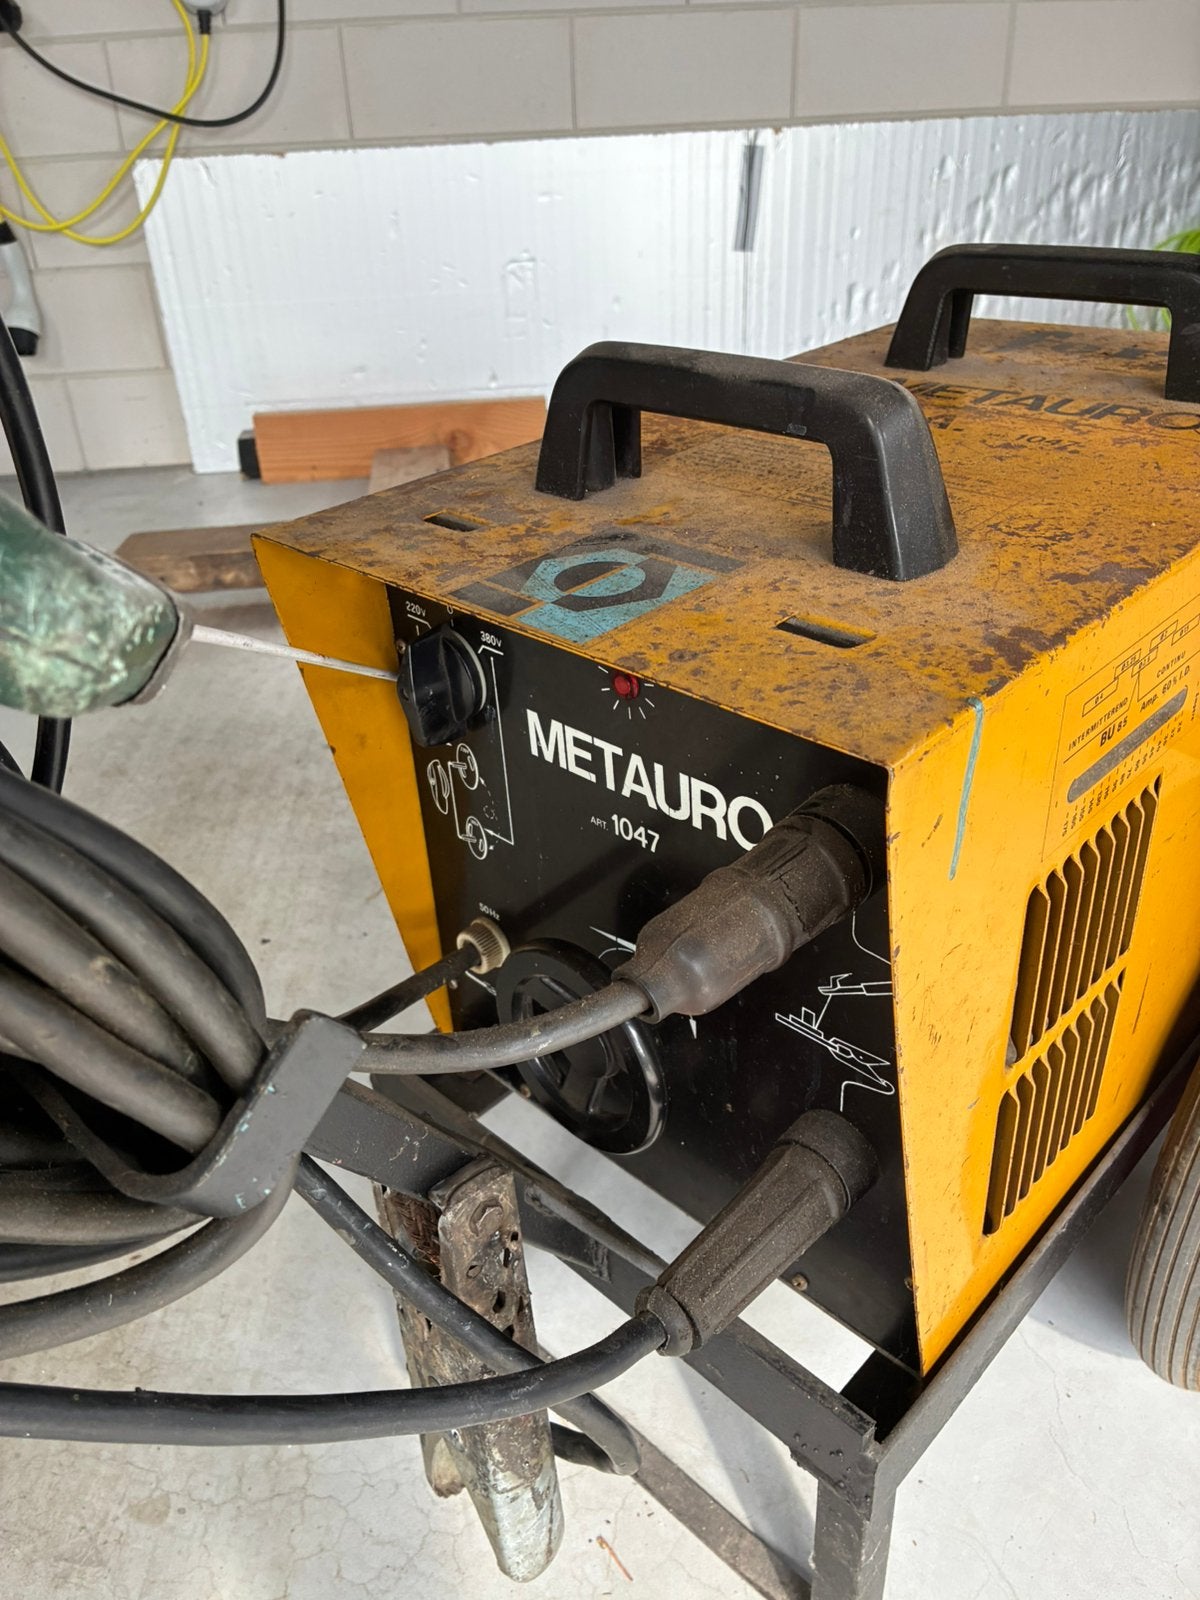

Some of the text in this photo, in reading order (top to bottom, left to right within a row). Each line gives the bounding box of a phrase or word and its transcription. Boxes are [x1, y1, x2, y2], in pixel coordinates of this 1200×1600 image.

[405, 601, 426, 617] 220V
[480, 631, 502, 647] 380V
[1157, 651, 1186, 678] CONTINU
[1068, 697, 1128, 751] INTERMITTEREND
[1100, 724, 1116, 747] BU
[526, 708, 774, 852] METAURO
[590, 813, 660, 853] ART. 1047
